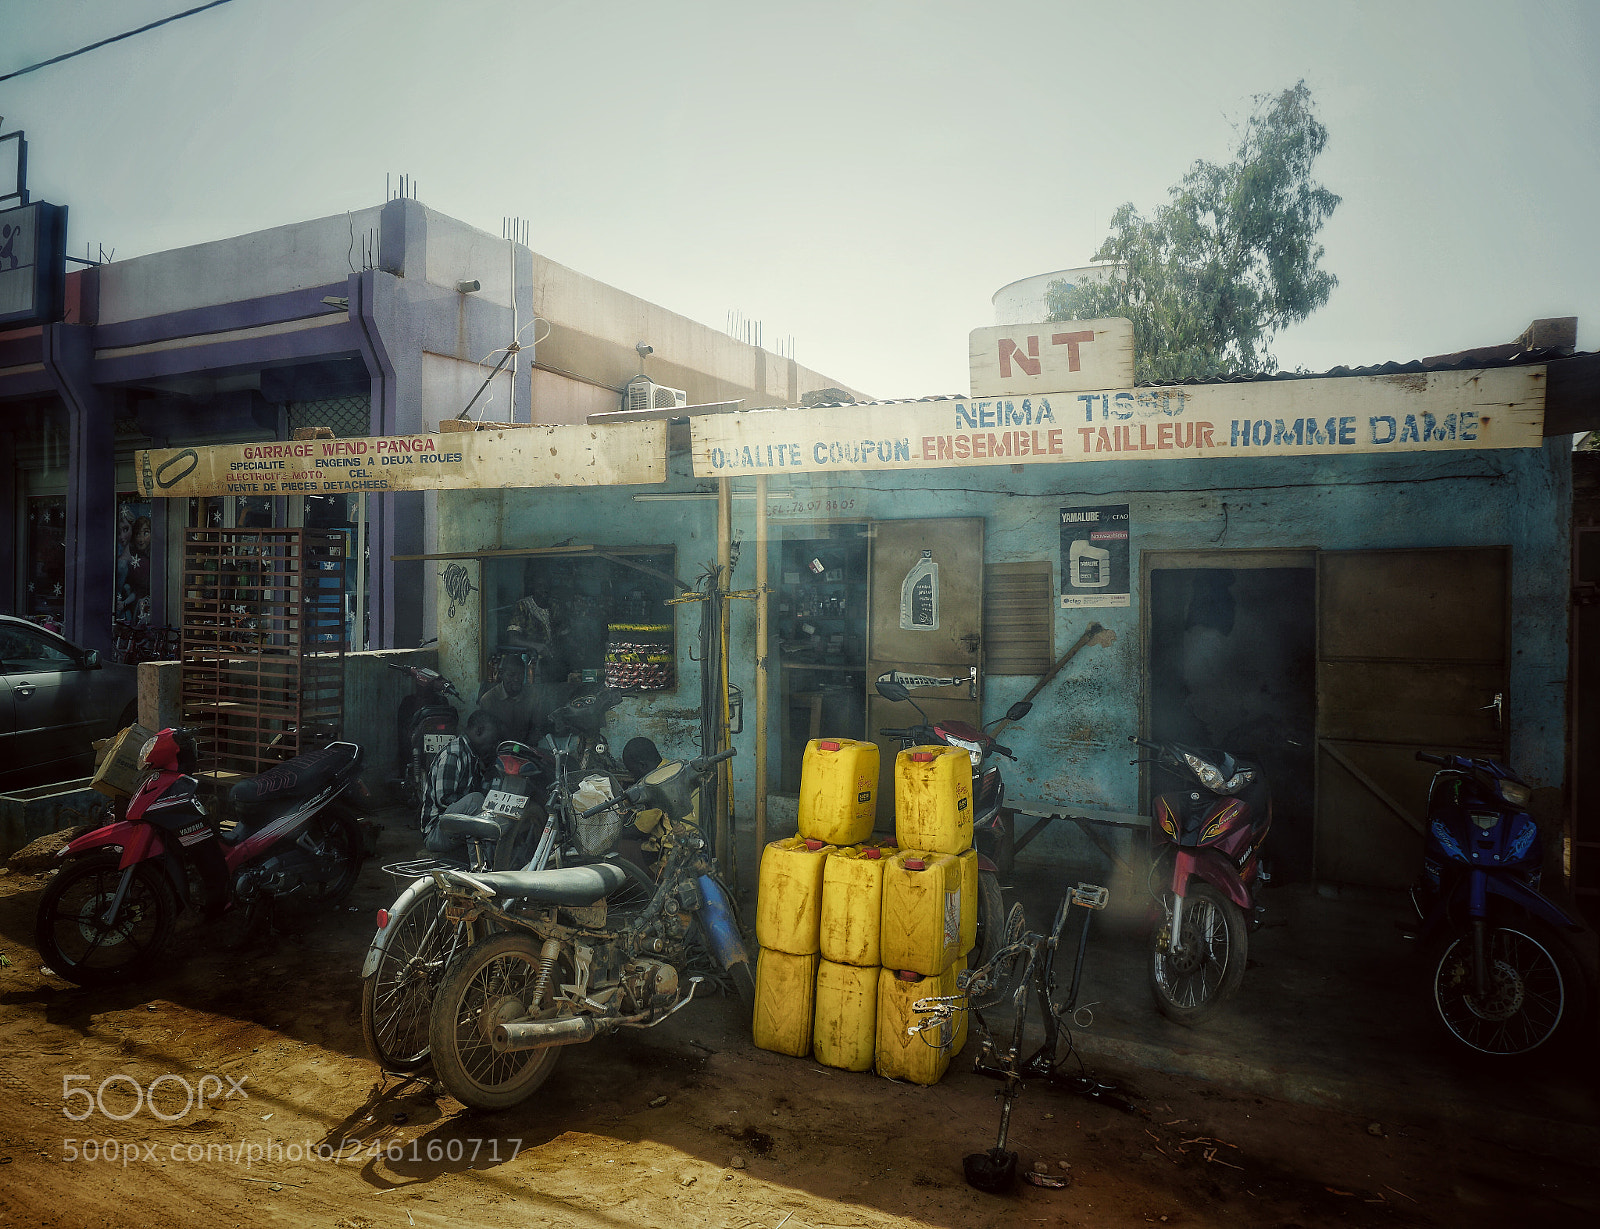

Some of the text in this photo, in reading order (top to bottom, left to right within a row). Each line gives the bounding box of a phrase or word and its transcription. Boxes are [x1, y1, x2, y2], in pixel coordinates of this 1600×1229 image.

[955, 397, 1056, 430] NEIMA
[813, 438, 910, 465] COUPON
[922, 429, 1064, 461] ENSEMBLE
[1077, 421, 1216, 453] TAILLEUR
[1230, 416, 1357, 447] HOMME
[1368, 410, 1480, 445] DAME
[243, 438, 436, 460] GARRAGE WEND-PANGA
[230, 460, 285, 471] SPECIALITE
[315, 458, 361, 468] ENGEINS
[367, 456, 375, 466] A
[381, 455, 413, 466] DEUX
[420, 452, 462, 463] ROUES
[227, 480, 392, 492] VENTE DE PIECES DETACHEES.
[840, 499, 855, 510] 05
[1061, 511, 1101, 523] YAMALUBE
